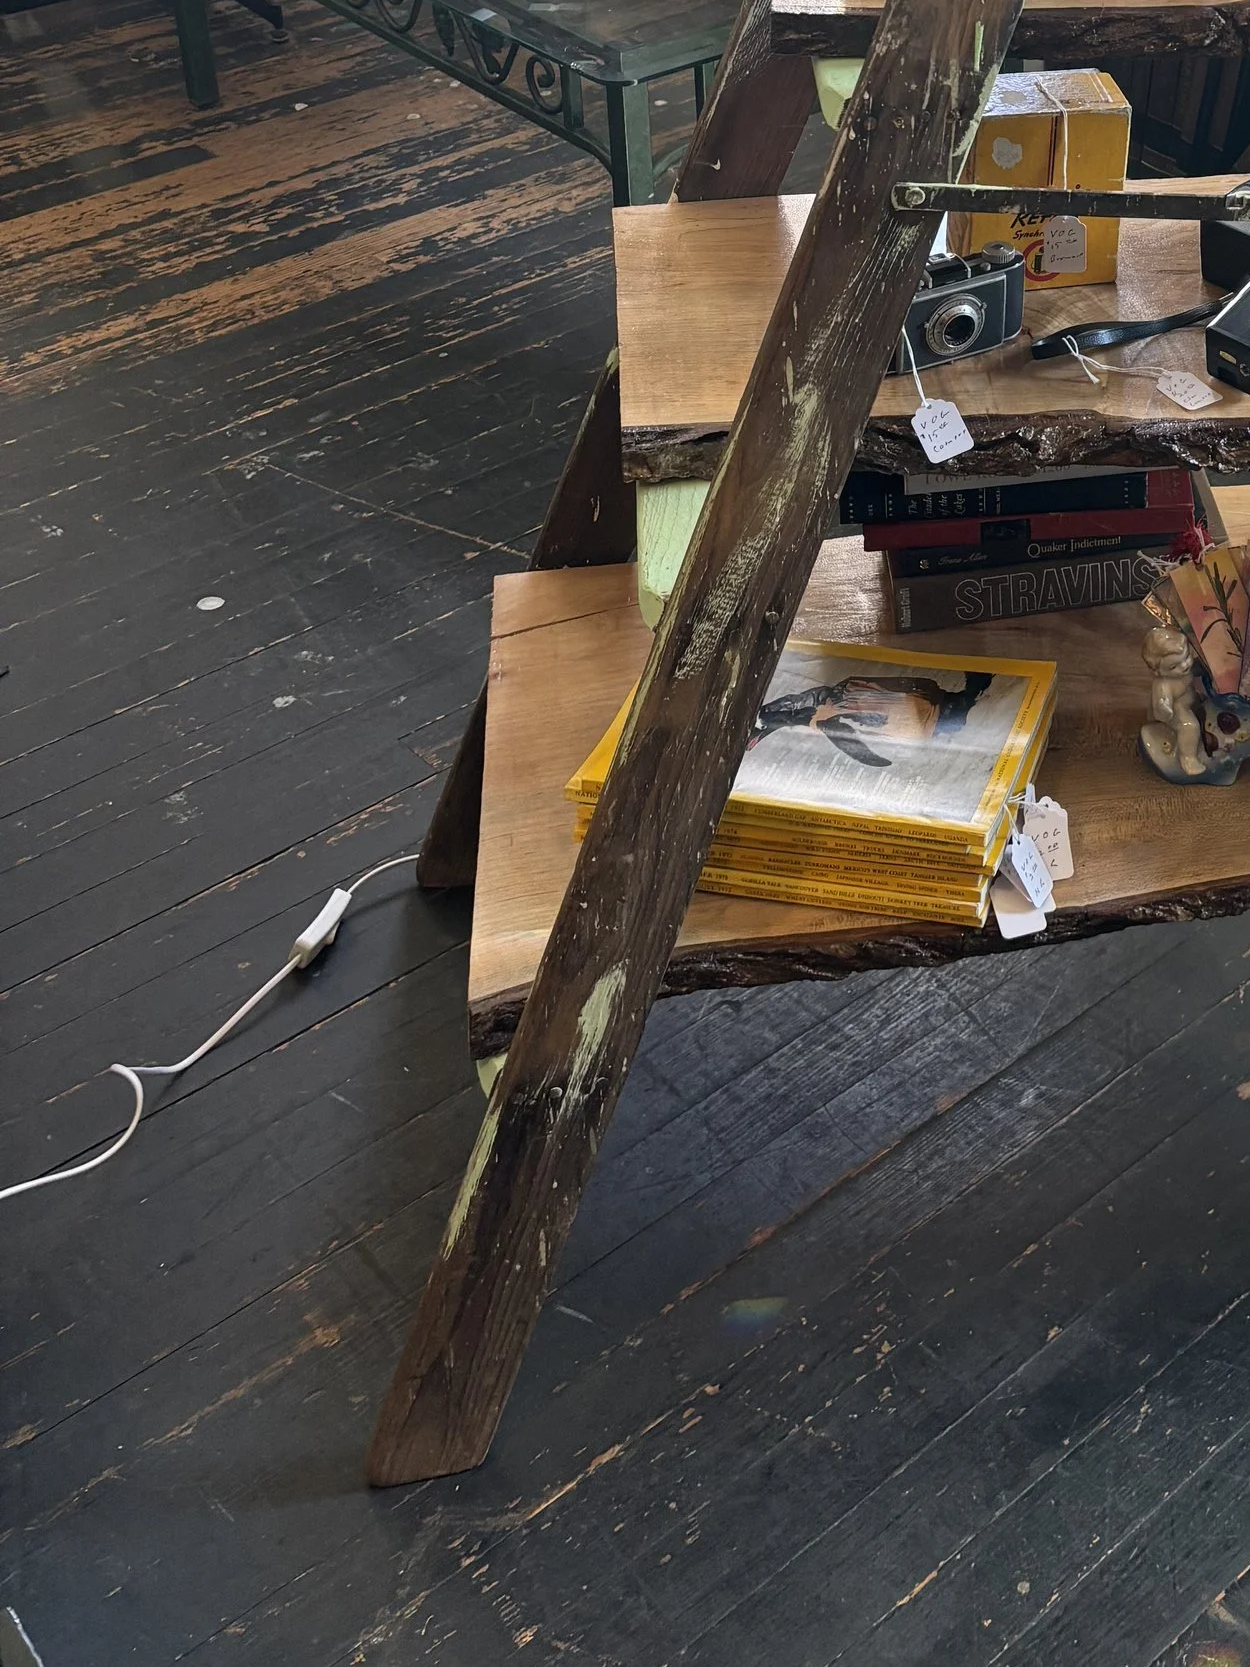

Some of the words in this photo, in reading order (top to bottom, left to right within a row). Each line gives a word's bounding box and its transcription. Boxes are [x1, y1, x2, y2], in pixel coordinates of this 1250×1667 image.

[1027, 539, 1068, 559] Quaker
[1069, 534, 1122, 554] Indictment
[954, 556, 1160, 622] STRAVINS
